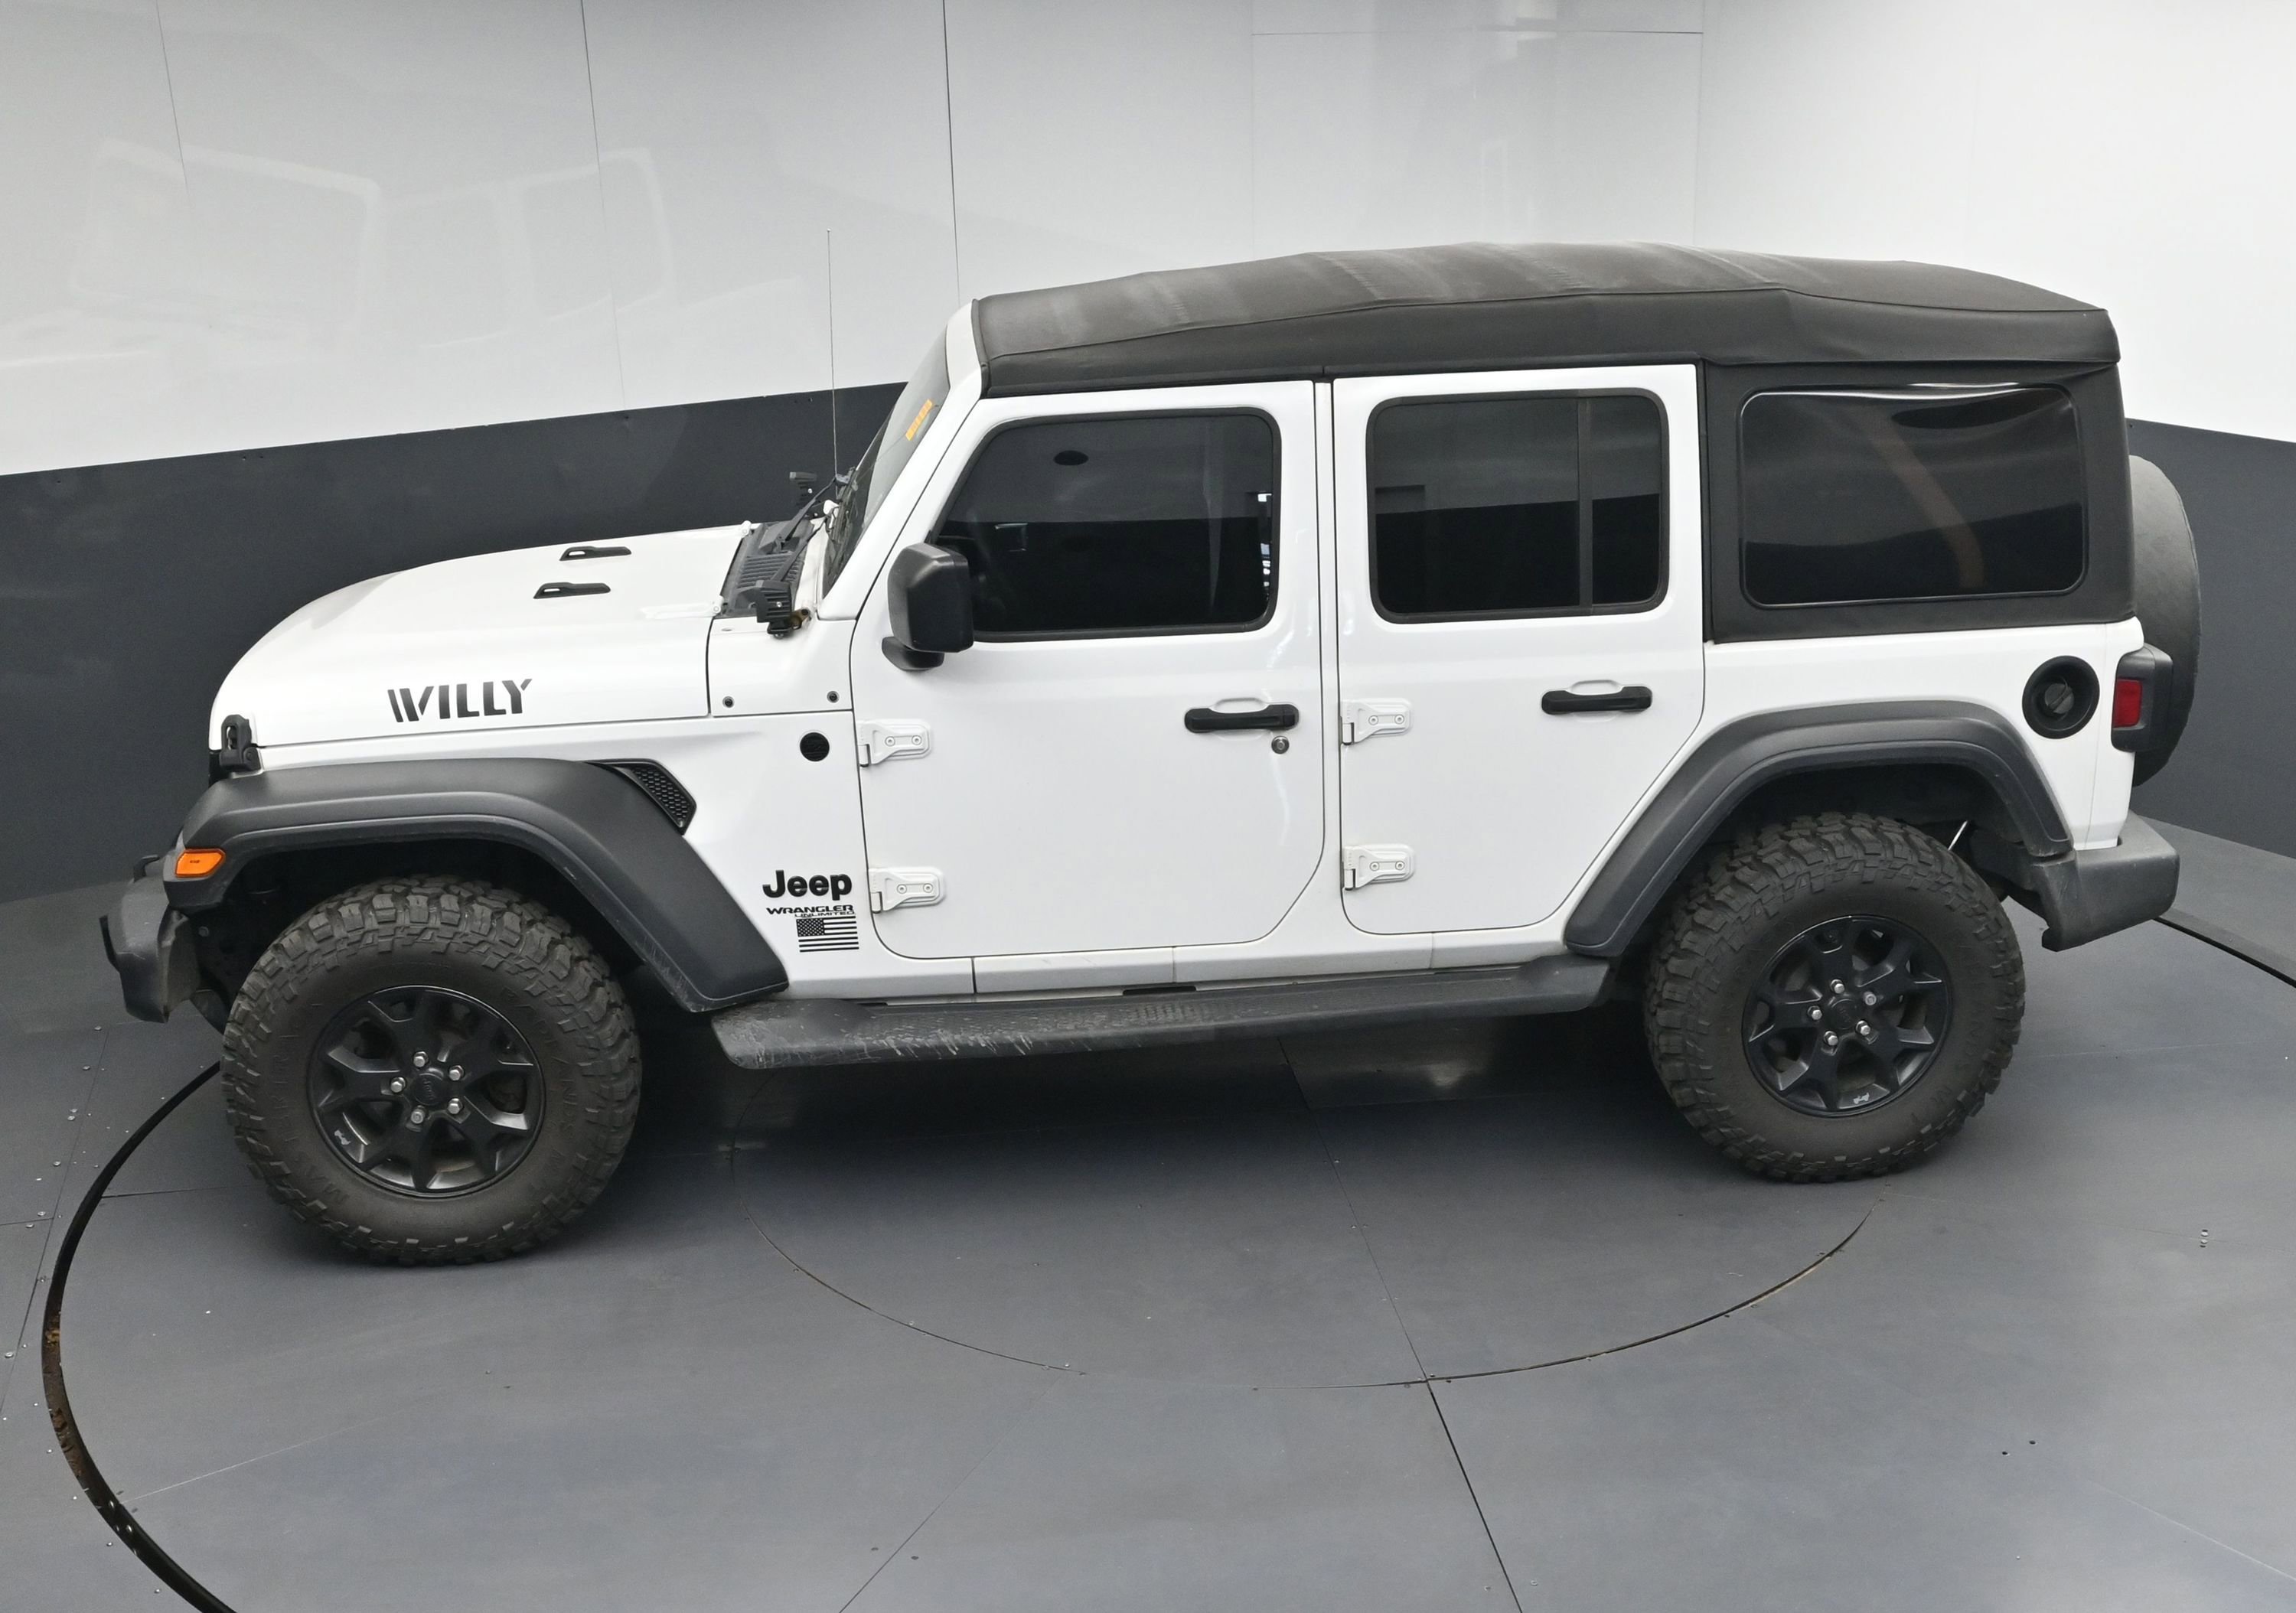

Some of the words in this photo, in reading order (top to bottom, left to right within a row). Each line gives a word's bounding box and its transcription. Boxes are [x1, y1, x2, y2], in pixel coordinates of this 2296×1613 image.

[387, 679, 533, 722] WILLY
[762, 869, 852, 901] Jeep
[766, 904, 853, 914] WRANGLER
